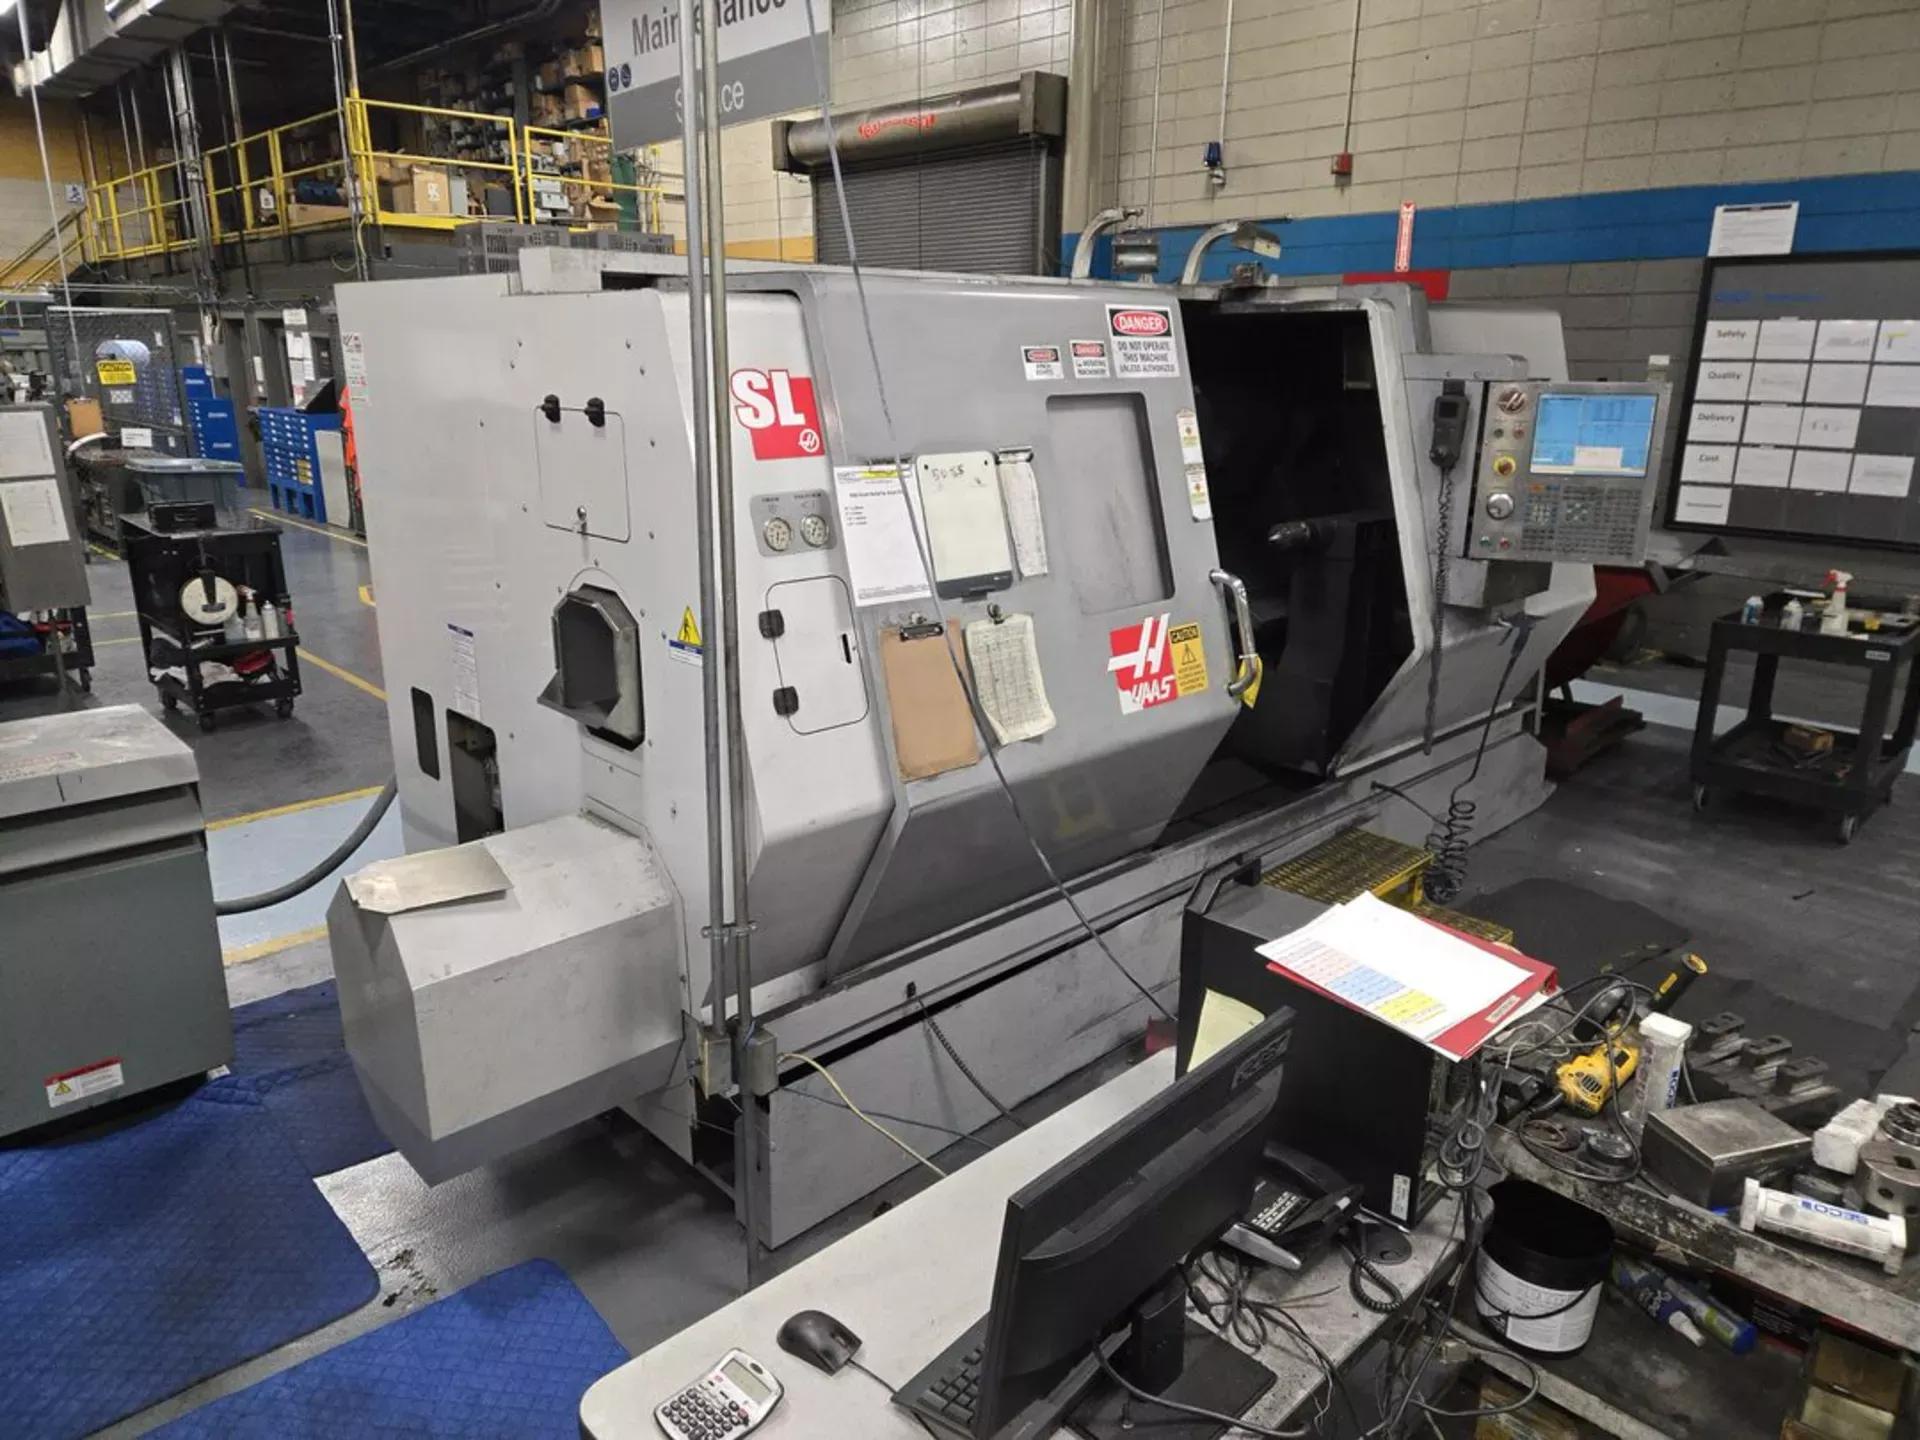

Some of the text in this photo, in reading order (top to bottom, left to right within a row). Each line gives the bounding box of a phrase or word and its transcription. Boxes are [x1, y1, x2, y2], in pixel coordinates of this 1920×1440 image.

[1119, 314, 1163, 331] DANGER
[1716, 329, 1747, 340] Safety
[1117, 341, 1170, 351] DO NOT OPERATE
[1123, 352, 1169, 362] THIS MACHINE
[1120, 363, 1175, 373] UNLESS AUTHORIZED
[1708, 371, 1741, 381] Quality
[730, 368, 806, 429] SL
[1698, 413, 1736, 423] Delivery
[1699, 454, 1720, 463] Cost
